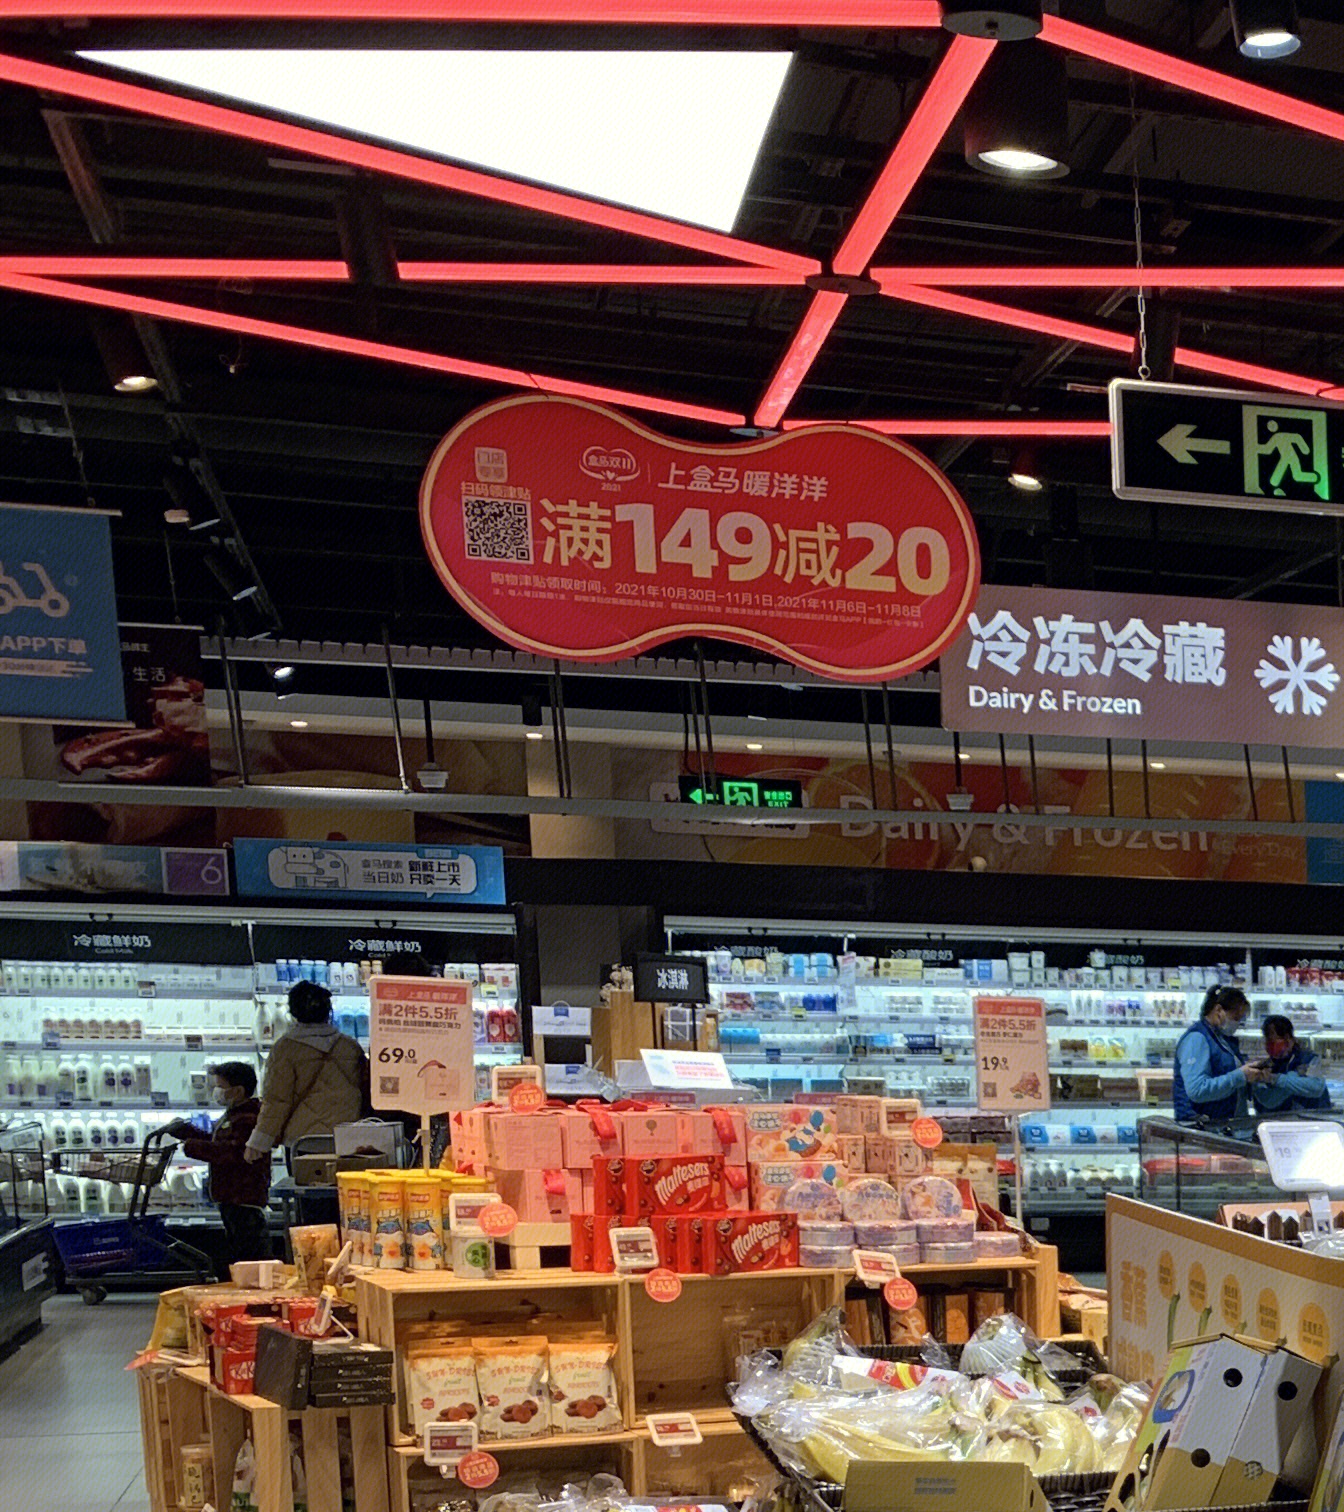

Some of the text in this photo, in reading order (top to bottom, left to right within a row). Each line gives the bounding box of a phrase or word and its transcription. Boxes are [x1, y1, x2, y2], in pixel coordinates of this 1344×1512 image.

[658, 461, 829, 502] 上盒马暖洋洋
[539, 498, 951, 597] 满149减20
[966, 611, 1228, 688] 冷冻冷藏
[968, 685, 1142, 716] Dairy & Frozen
[408, 859, 461, 874] 新鲜上市
[72, 933, 151, 950] 冷藏鲜奶
[348, 938, 421, 955] 冷藏鲜奶
[378, 1047, 416, 1063] 69.0
[655, 1161, 710, 1205] Maltesers
[731, 1219, 782, 1263] Maltesers
